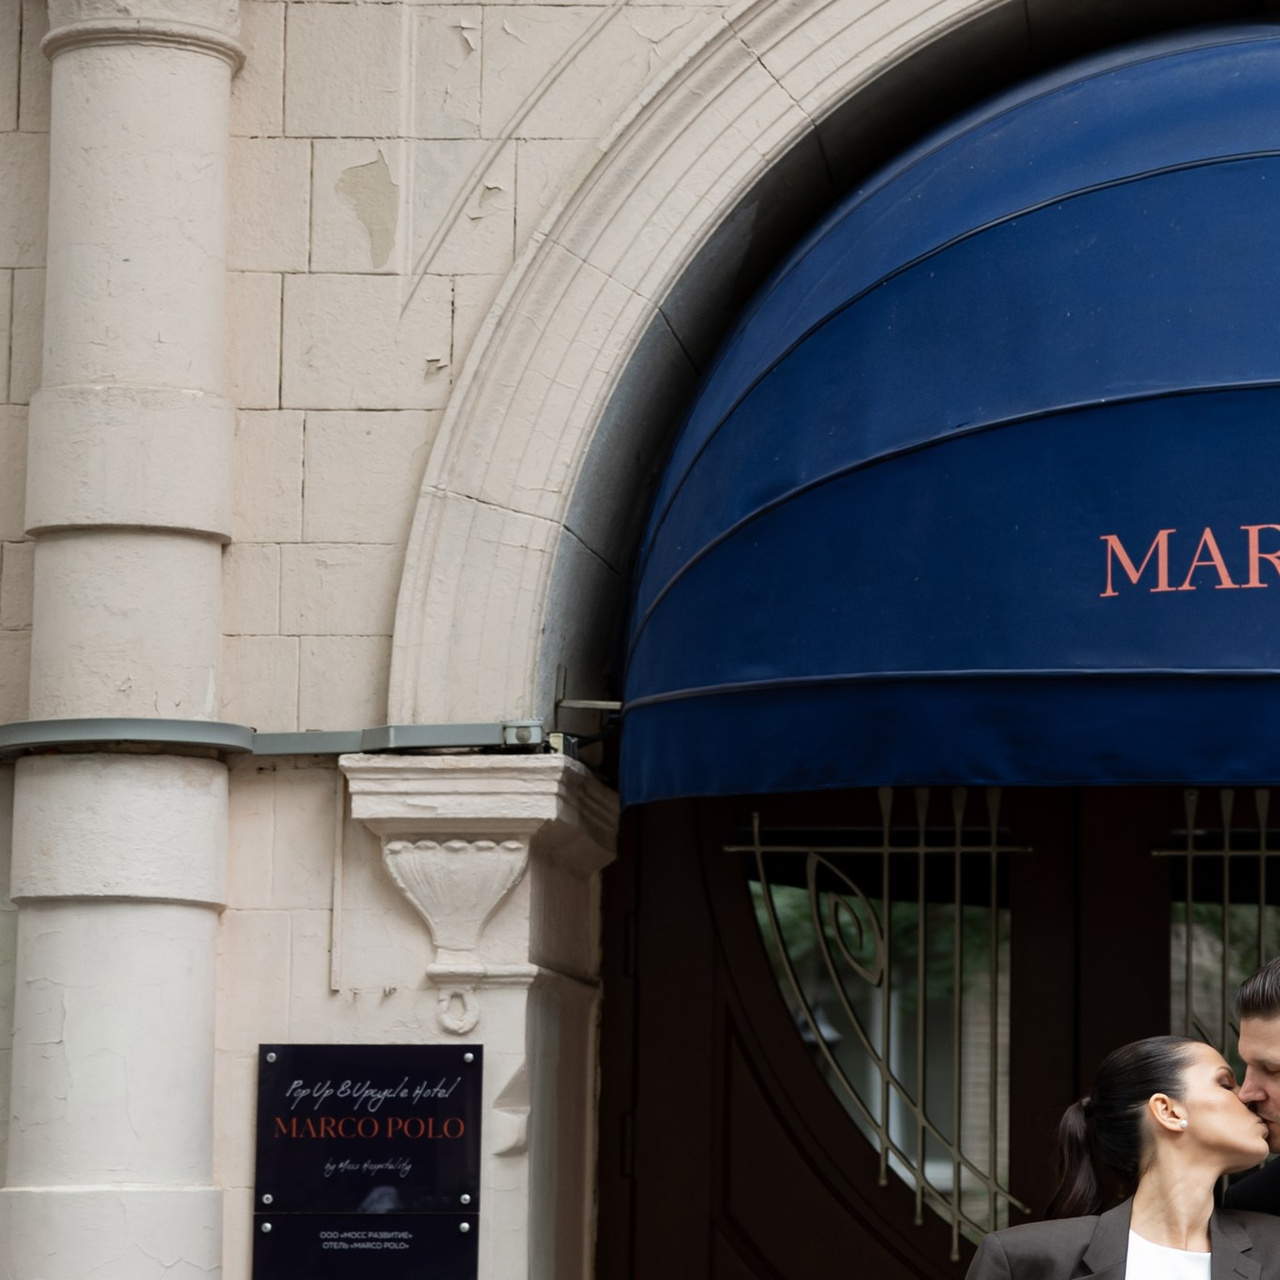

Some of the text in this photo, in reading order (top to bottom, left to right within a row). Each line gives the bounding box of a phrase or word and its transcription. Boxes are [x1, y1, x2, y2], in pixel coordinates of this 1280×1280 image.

[285, 1079, 310, 1110] Pop
[313, 1079, 334, 1110] Up
[352, 1076, 410, 1113] Upcycle
[412, 1076, 462, 1106] Hotel
[274, 1116, 465, 1139] MARCO POLO
